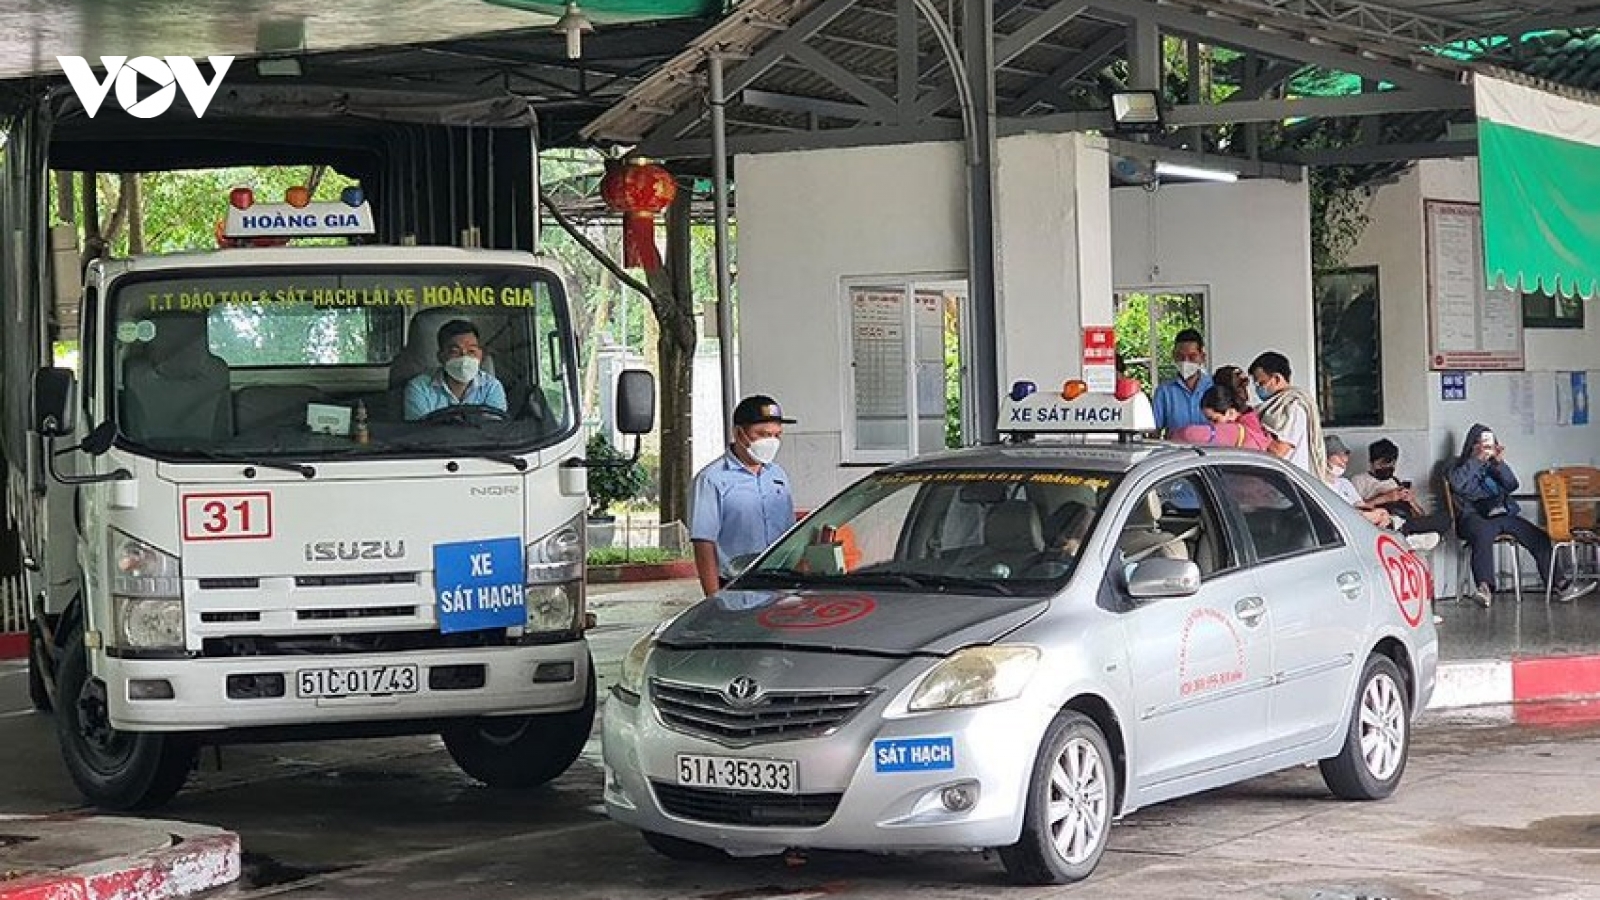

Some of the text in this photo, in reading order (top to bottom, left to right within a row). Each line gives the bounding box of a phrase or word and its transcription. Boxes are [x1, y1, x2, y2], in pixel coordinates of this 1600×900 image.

[242, 210, 360, 229] HOÀNG GIA
[148, 293, 173, 311] T.T
[258, 289, 273, 307] &
[275, 286, 308, 308] SÁT
[362, 283, 389, 306] LÁI
[394, 288, 416, 306] XE
[422, 281, 495, 306] HOÀNG
[500, 287, 536, 308] GIA
[1011, 404, 1123, 426] XE SÁT HẠCH
[470, 485, 519, 497] NQR
[202, 500, 250, 533] 31
[304, 540, 406, 562] ISUZU
[470, 552, 494, 577] XE
[1387, 554, 1421, 602] 26
[441, 584, 524, 614] SÁT HẠCH
[878, 743, 952, 768] SÁT HẠCH
[680, 756, 791, 791] 51A-353.33
